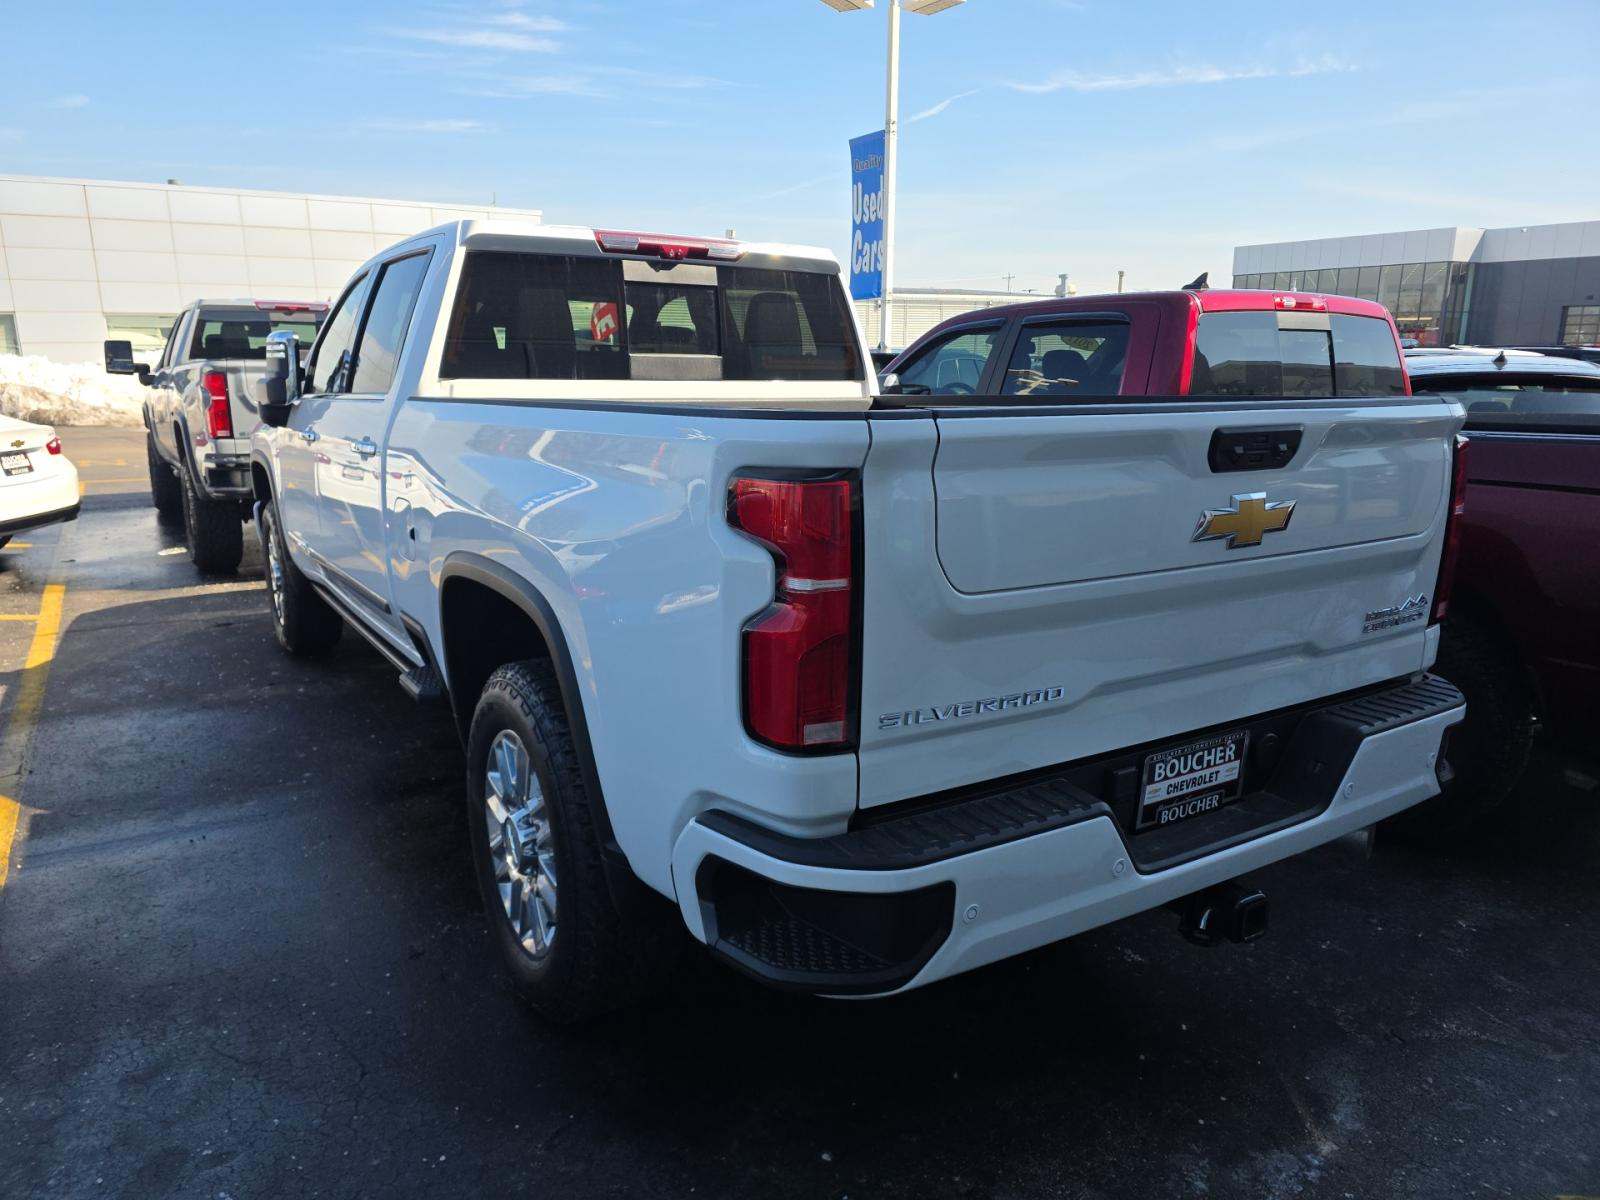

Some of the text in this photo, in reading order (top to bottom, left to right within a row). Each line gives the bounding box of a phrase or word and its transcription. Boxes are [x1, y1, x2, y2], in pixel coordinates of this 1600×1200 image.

[852, 175, 885, 225] Used
[852, 229, 885, 274] Cars
[878, 685, 1065, 730] SILVERADO
[1154, 743, 1236, 782] BOUCHER
[1166, 770, 1220, 795] CHEVROLET
[1160, 794, 1219, 824] BOUCHER
